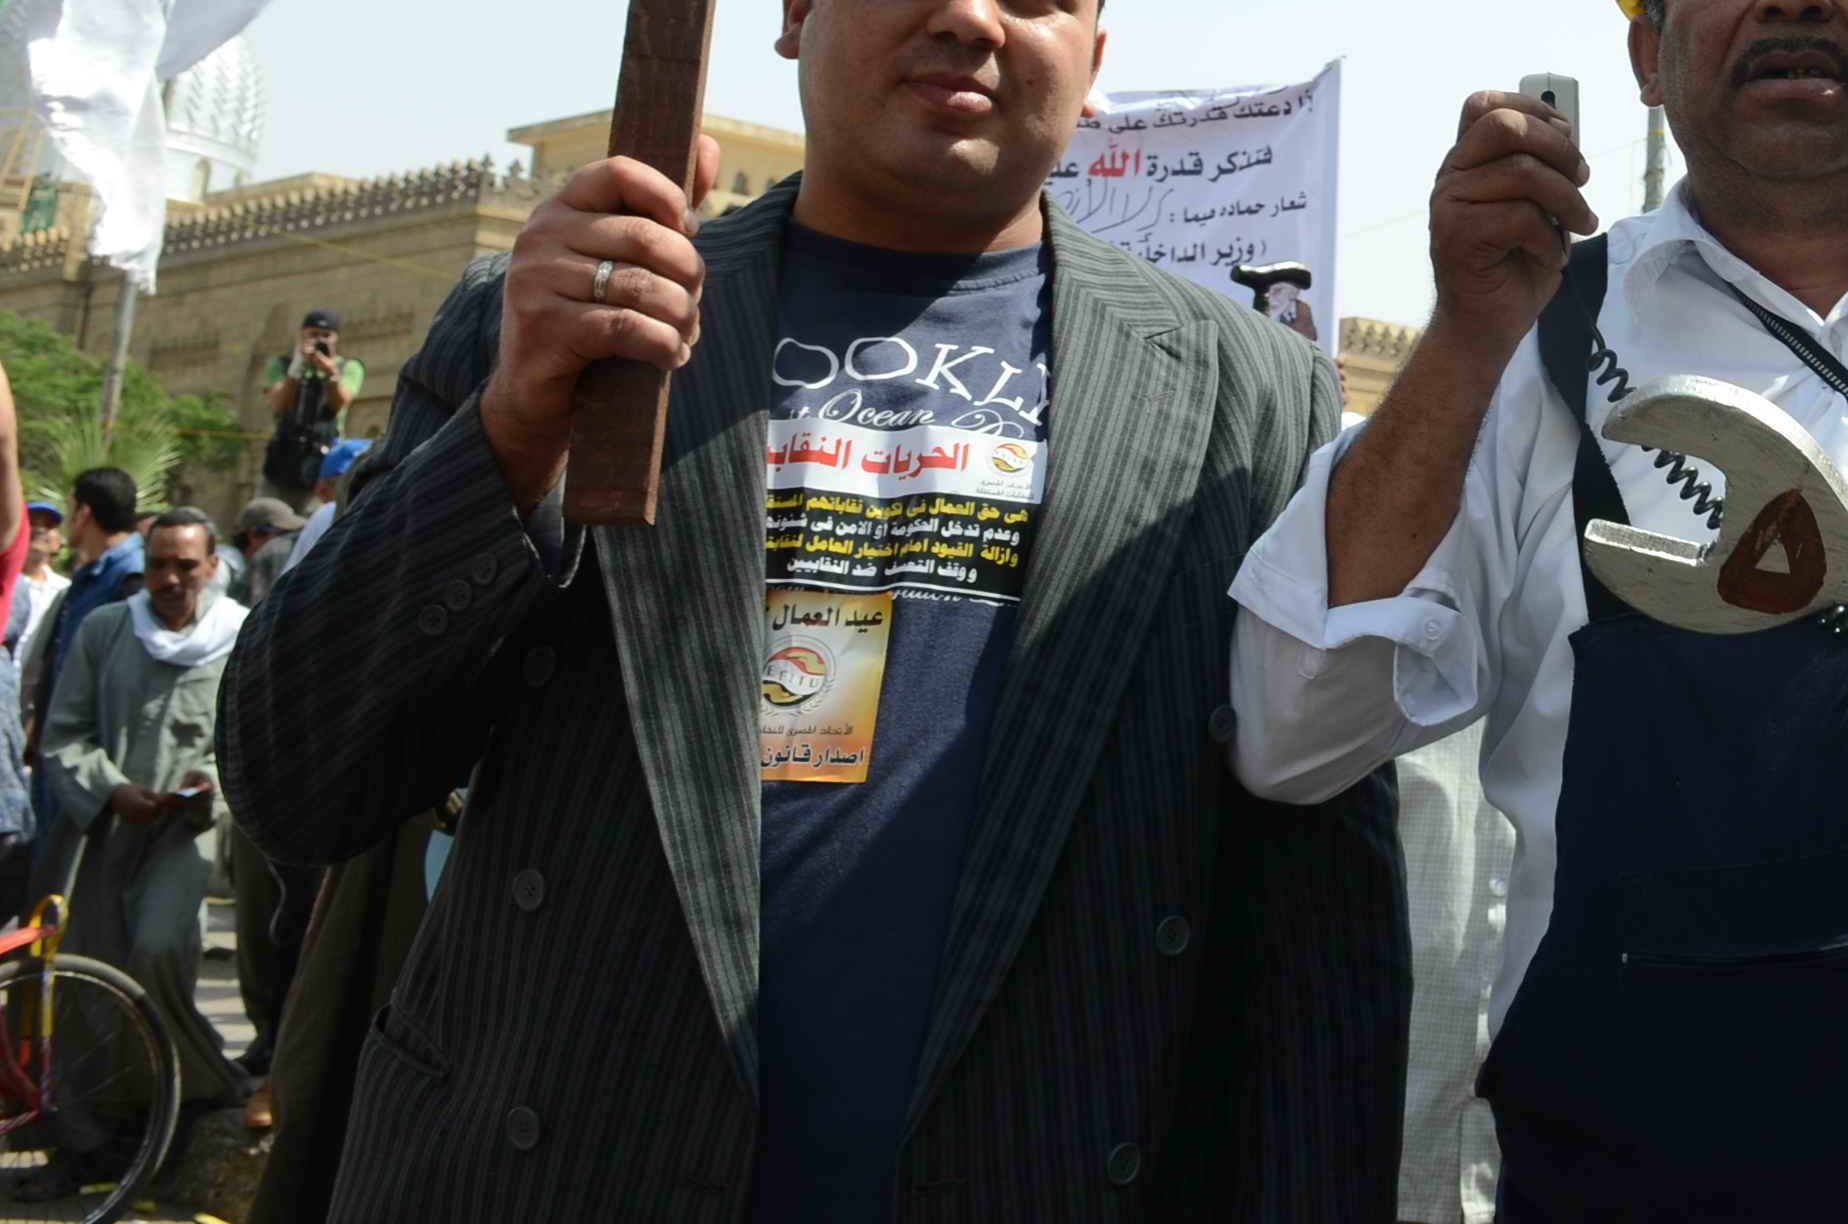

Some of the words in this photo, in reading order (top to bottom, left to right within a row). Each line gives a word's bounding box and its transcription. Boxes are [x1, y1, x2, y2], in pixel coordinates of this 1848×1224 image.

[1109, 114, 1148, 134] على
[1147, 152, 1204, 183] قدرة
[818, 388, 936, 427] Ocean
[862, 442, 970, 481] الحريات
[928, 497, 976, 517] العمال
[976, 503, 1000, 521] حق
[982, 528, 1021, 546] وعدم
[771, 602, 841, 631] العمال
[845, 608, 884, 633] عيد
[761, 743, 812, 767] قانون
[813, 746, 865, 769] اصدار
